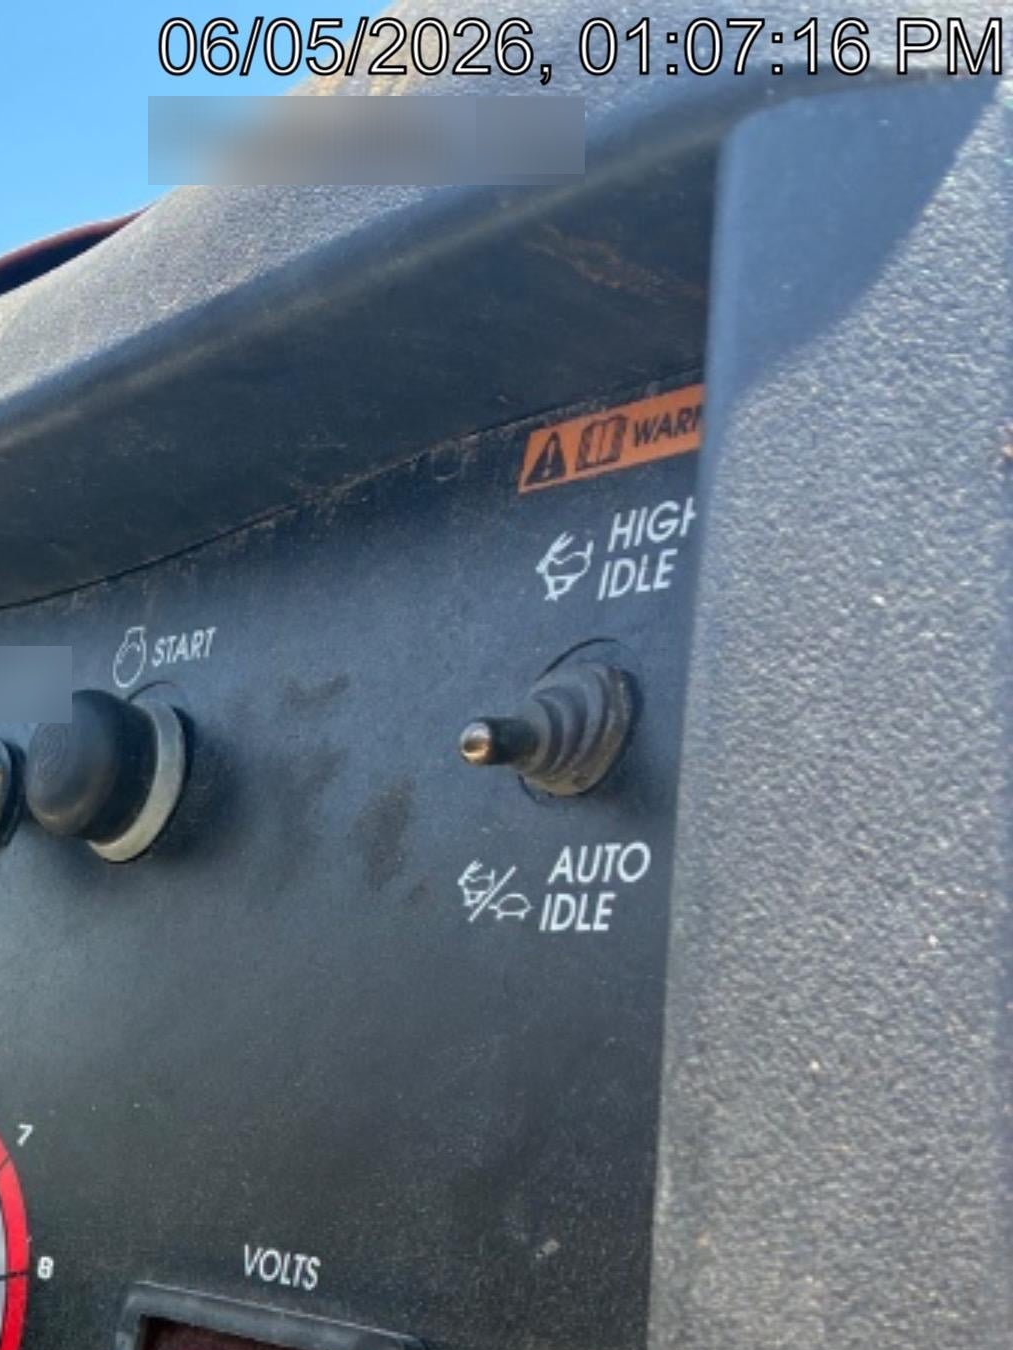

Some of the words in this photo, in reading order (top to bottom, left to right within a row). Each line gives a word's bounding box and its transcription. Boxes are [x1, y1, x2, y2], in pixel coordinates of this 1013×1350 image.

[631, 407, 704, 447] WAR
[597, 548, 678, 600] IDLE
[151, 626, 218, 667] START
[547, 841, 652, 884] AUTO
[538, 892, 617, 931] IDLE
[16, 1124, 33, 1146] 7
[37, 1257, 54, 1279] 8
[243, 1244, 321, 1291] VOLTS
